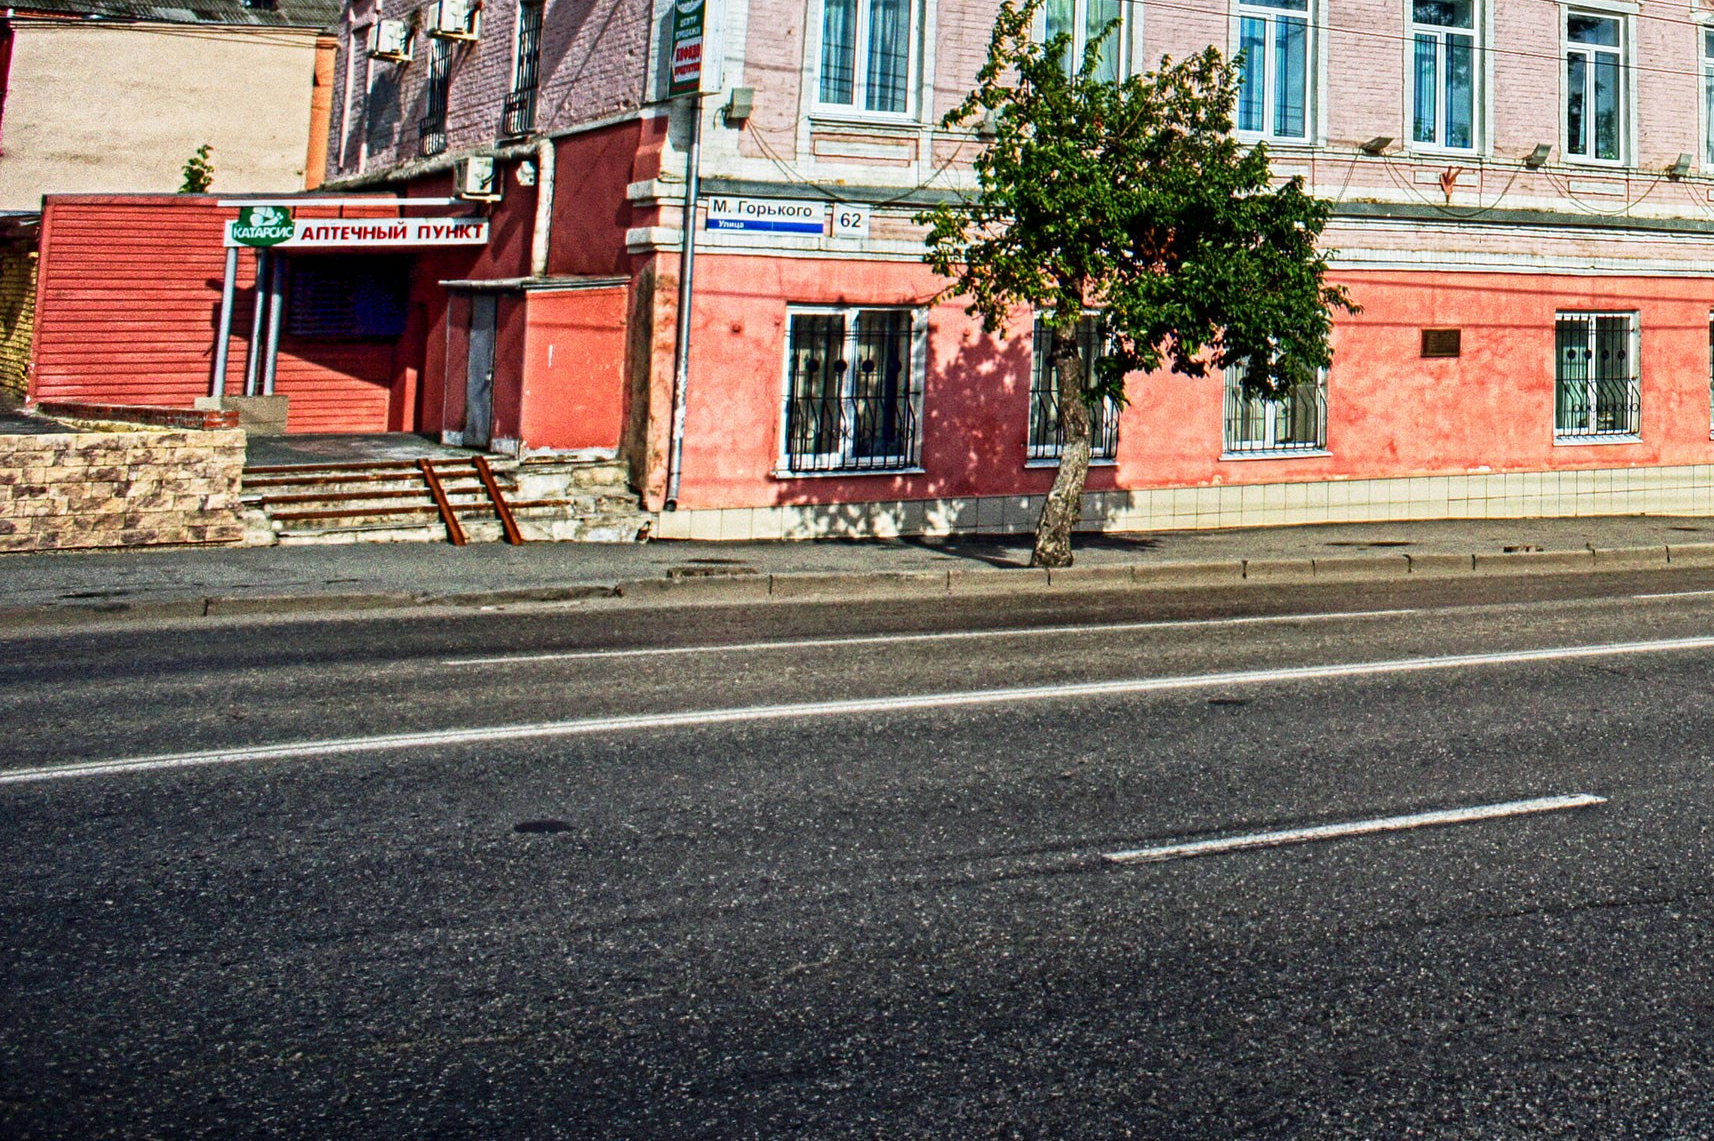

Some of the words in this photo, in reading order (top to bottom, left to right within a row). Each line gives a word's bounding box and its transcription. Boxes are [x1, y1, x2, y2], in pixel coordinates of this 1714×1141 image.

[713, 199, 732, 214] М.
[738, 200, 813, 217] Горького
[718, 220, 745, 229] Улица
[840, 213, 861, 228] 62
[233, 226, 294, 238] КАТАРСИС
[301, 221, 407, 240] АПТЕЧНЫЙ
[417, 224, 484, 239] ПУНКТ
